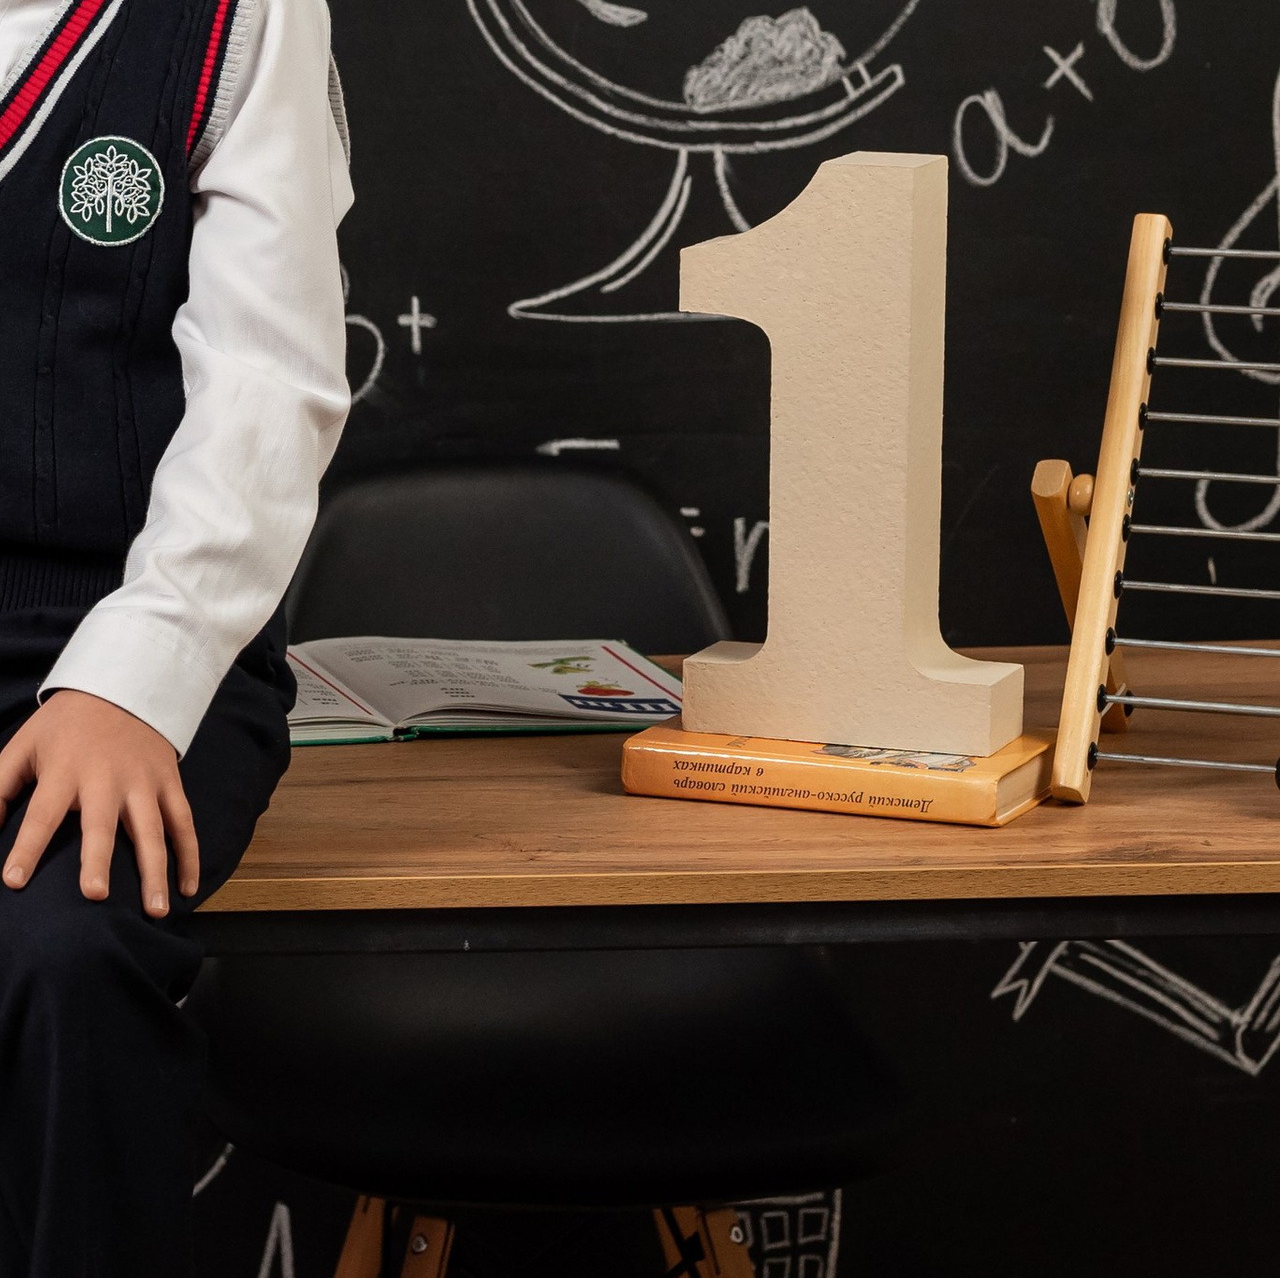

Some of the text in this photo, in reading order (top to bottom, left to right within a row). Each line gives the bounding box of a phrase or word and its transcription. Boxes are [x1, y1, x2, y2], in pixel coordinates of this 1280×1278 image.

[672, 759, 765, 777] в картинках
[673, 777, 933, 813] Детский русско-английский словарь
